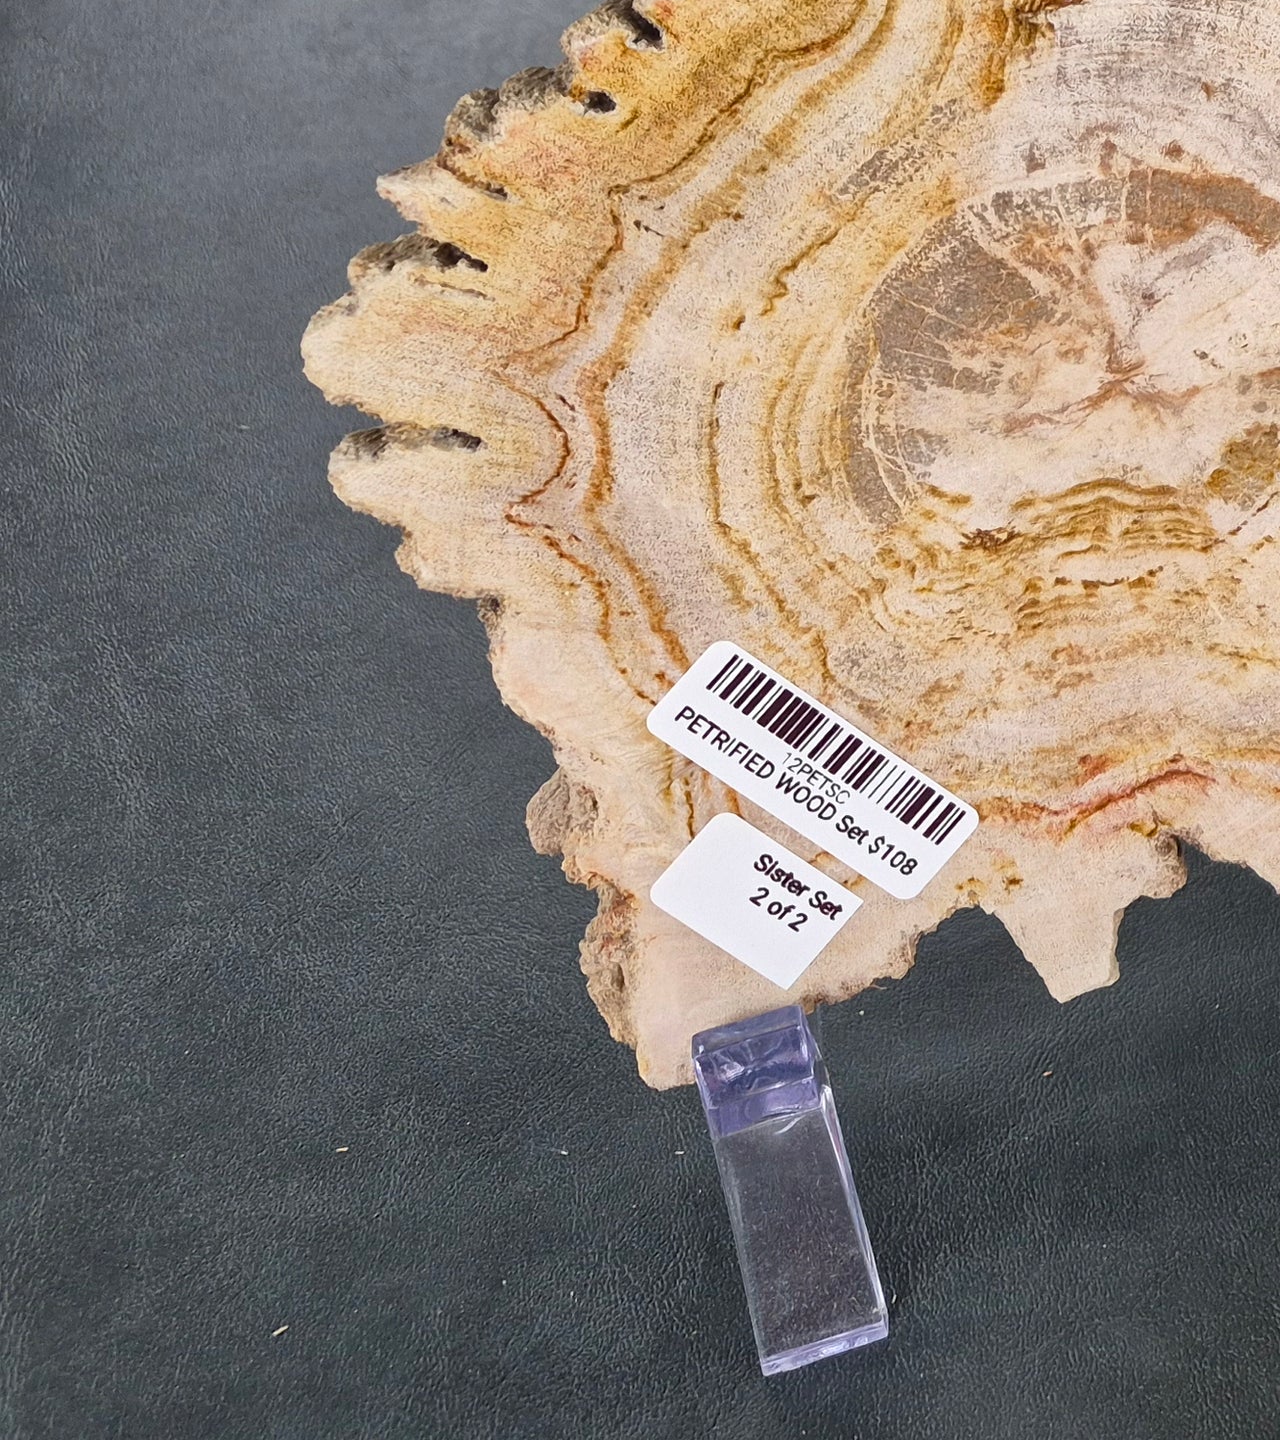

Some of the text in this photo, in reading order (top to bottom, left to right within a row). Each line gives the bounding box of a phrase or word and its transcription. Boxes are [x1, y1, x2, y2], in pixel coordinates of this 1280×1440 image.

[674, 705, 919, 877] PETRIFIED WOOD Set $108
[782, 752, 851, 804] 12PETSC
[749, 887, 809, 933] 2 of 2
[753, 853, 844, 921] Sister Set
